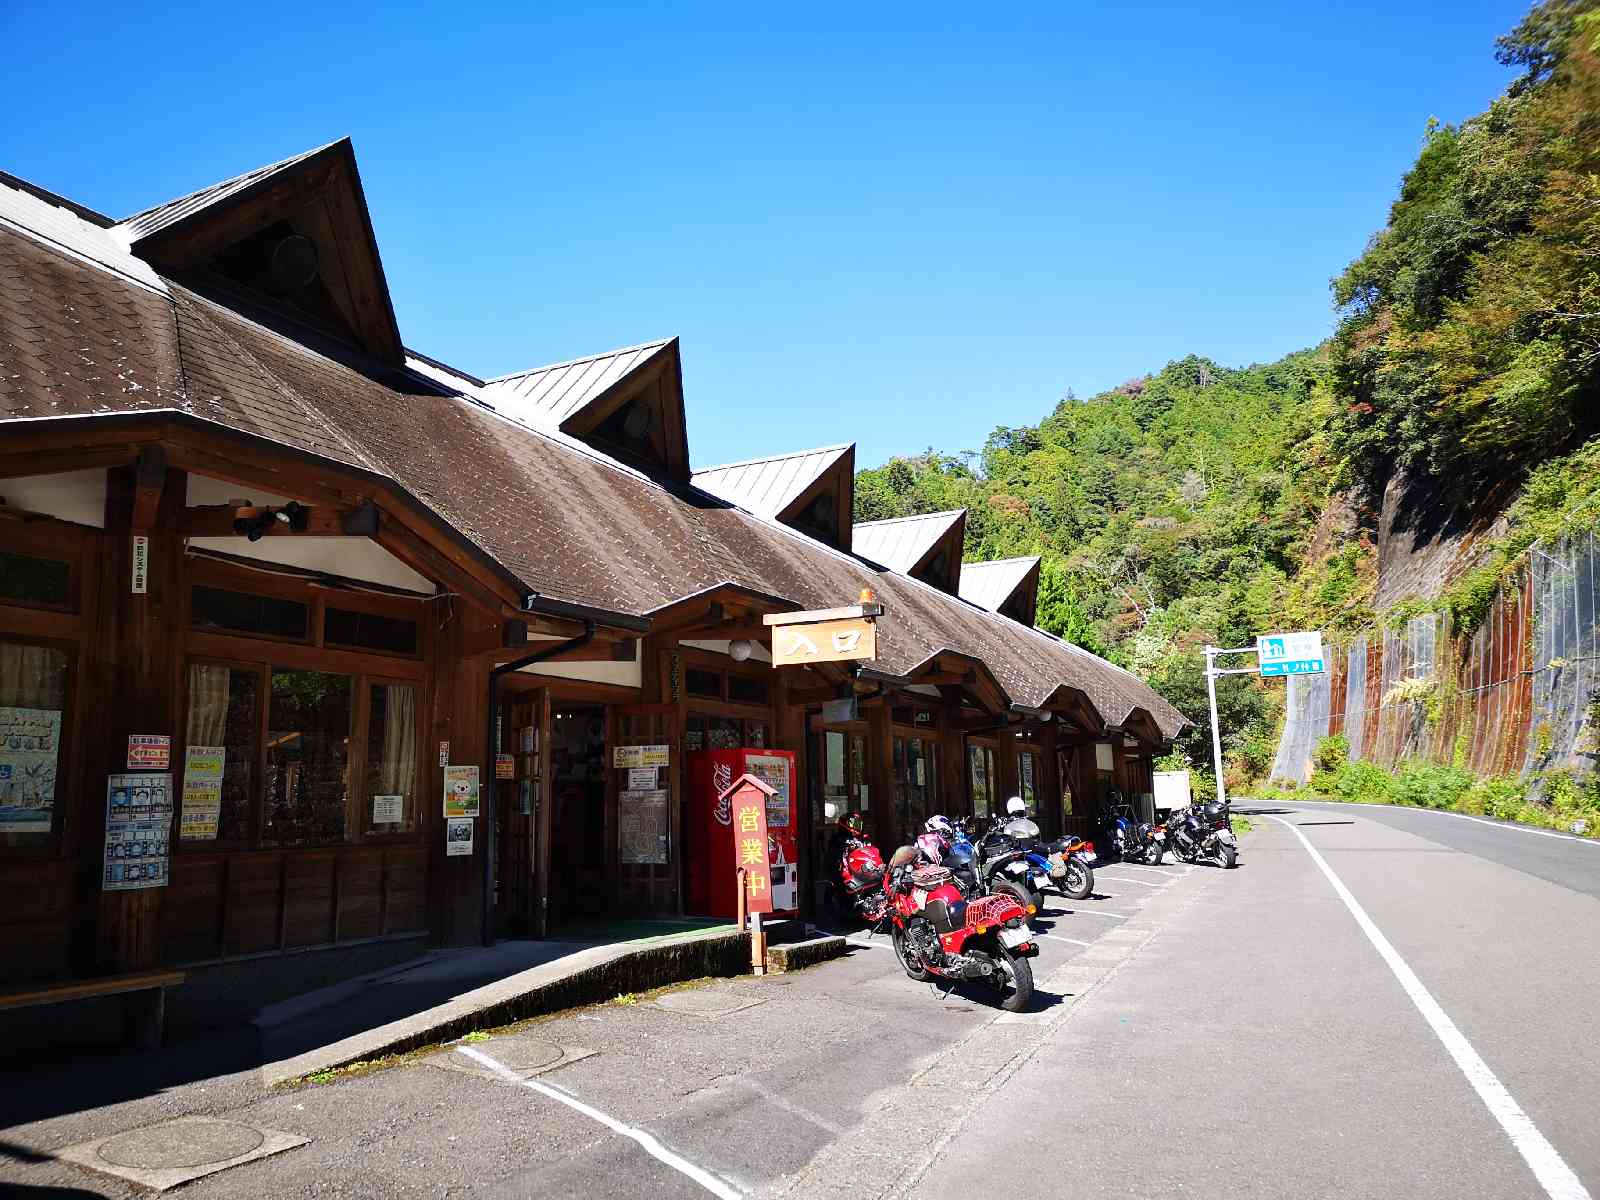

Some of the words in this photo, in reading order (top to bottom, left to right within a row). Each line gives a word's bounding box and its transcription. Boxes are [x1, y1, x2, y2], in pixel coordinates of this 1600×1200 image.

[783, 629, 861, 656] 入口
[713, 760, 732, 826] CocaCola
[739, 805, 765, 897] 営業中
